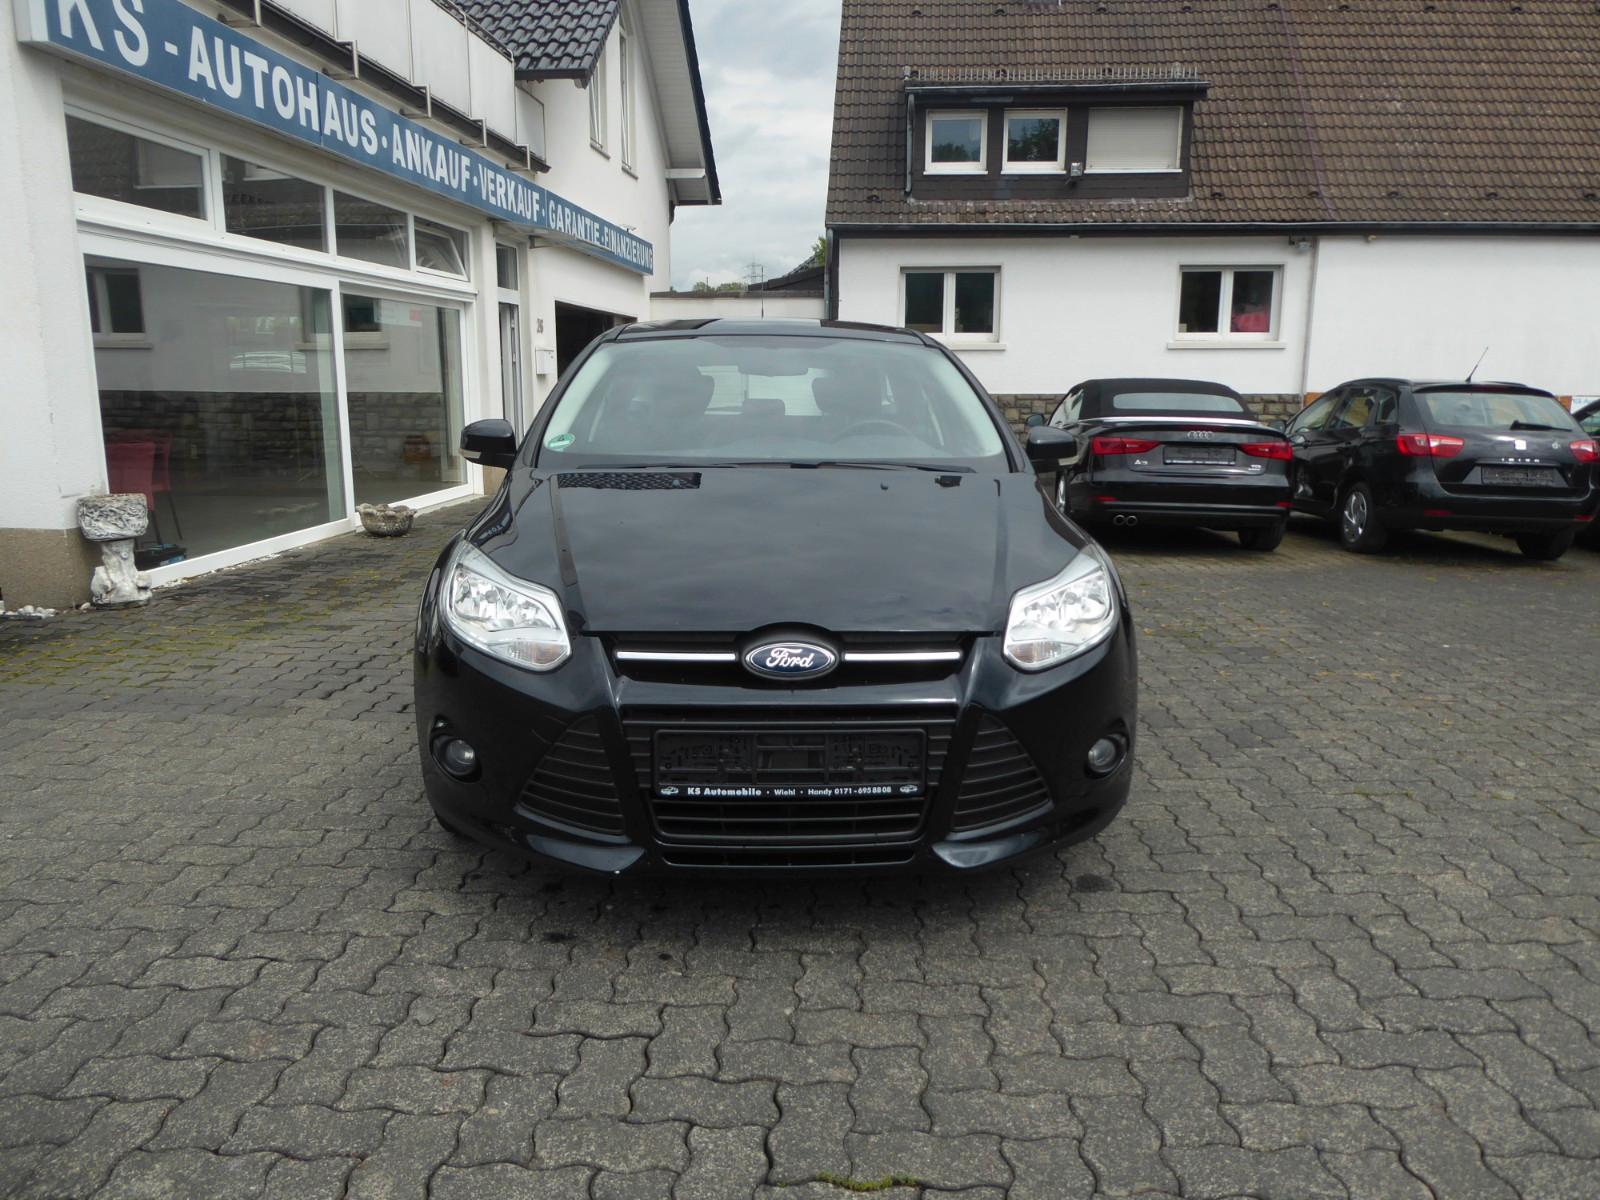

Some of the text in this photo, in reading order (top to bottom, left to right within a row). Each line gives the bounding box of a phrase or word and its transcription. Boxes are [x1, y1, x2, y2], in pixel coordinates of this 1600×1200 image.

[392, 123, 471, 193] ANKAUF
[478, 163, 541, 220] VERKAUF
[548, 200, 600, 245] GARANTIE
[603, 225, 653, 270] FINANZIERUNG
[765, 647, 815, 668] Ford
[687, 787, 701, 796] KS
[703, 787, 762, 796] Automobile
[774, 788, 796, 796] Wiehl
[807, 788, 833, 797] Handy
